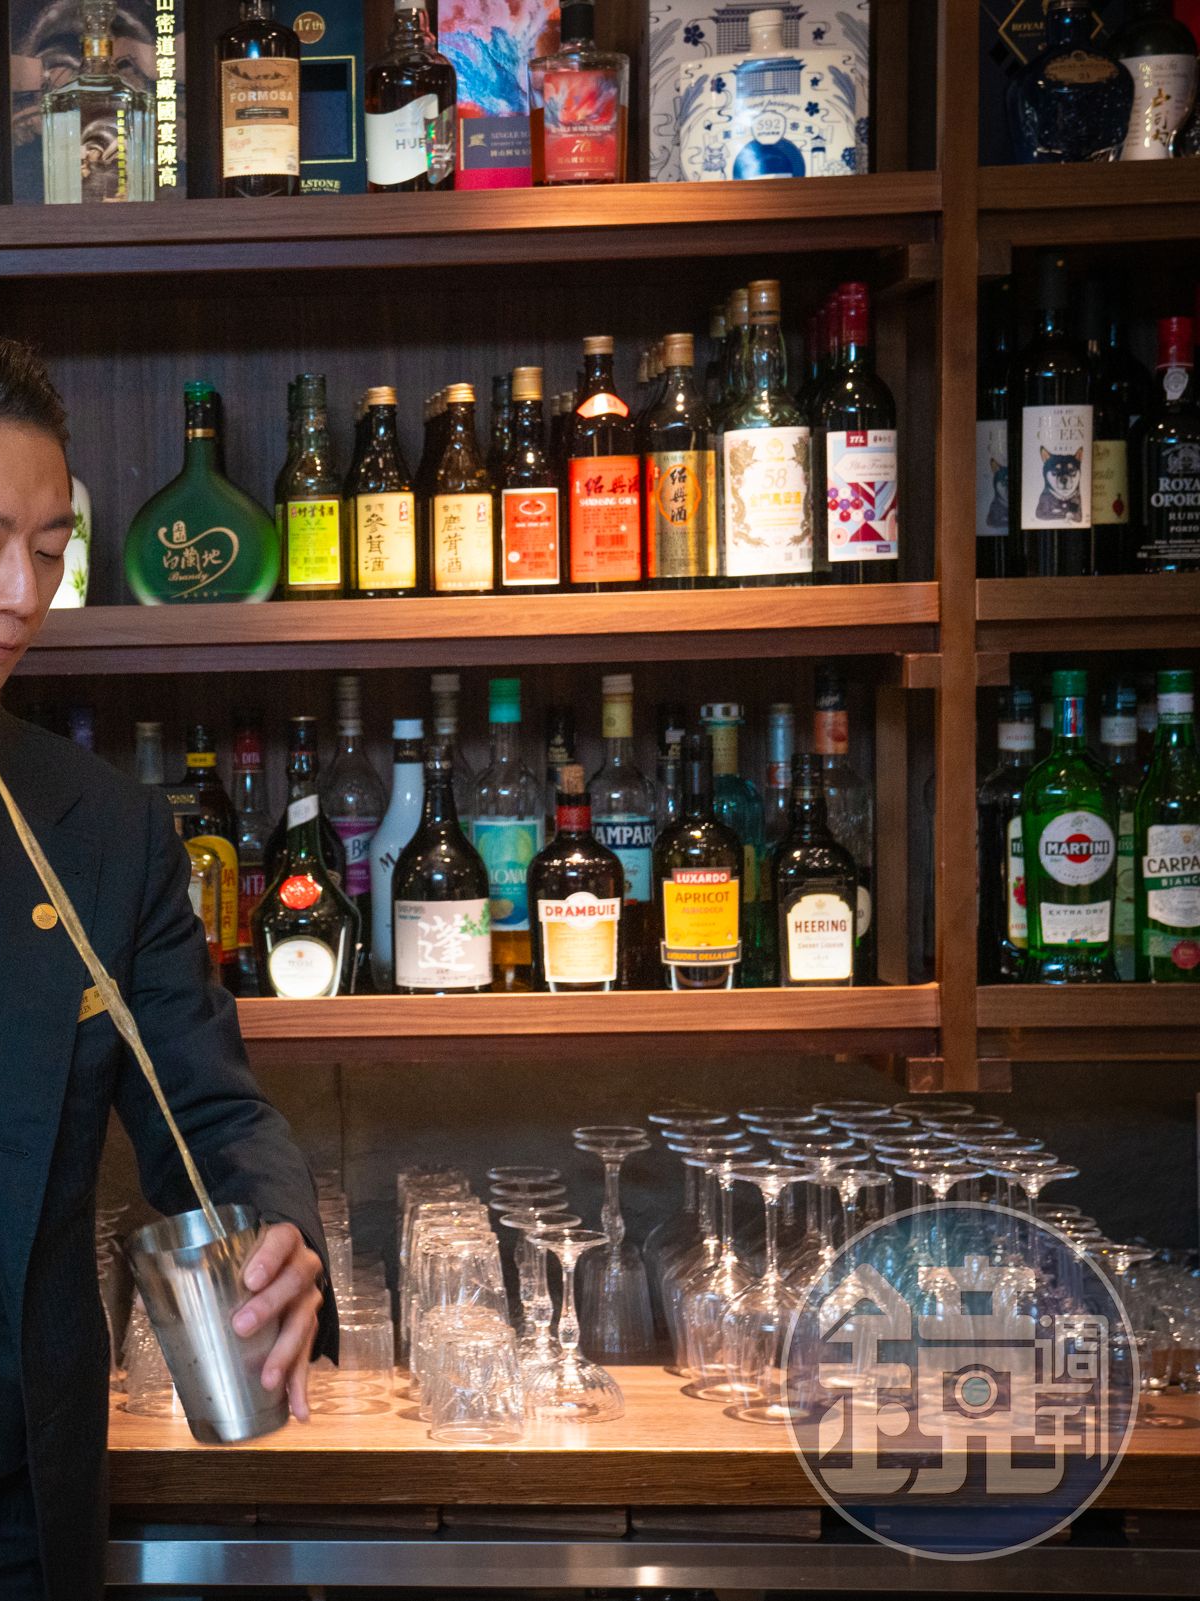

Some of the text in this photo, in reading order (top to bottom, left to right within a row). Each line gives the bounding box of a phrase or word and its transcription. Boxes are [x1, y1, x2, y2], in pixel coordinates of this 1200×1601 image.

[230, 90, 294, 103] FORMOSA
[301, 179, 341, 188] LSTONE
[849, 435, 865, 444] TTL
[764, 467, 788, 489] 58
[167, 571, 209, 583] Brandy
[592, 825, 655, 846] AMPARI
[1046, 841, 1109, 855] MARTINI
[676, 872, 728, 884] LUXARDO
[675, 890, 731, 904] APRICOT
[545, 904, 616, 917] DRAMBUIE
[1086, 908, 1104, 916] DRY
[794, 919, 847, 933] HEERING
